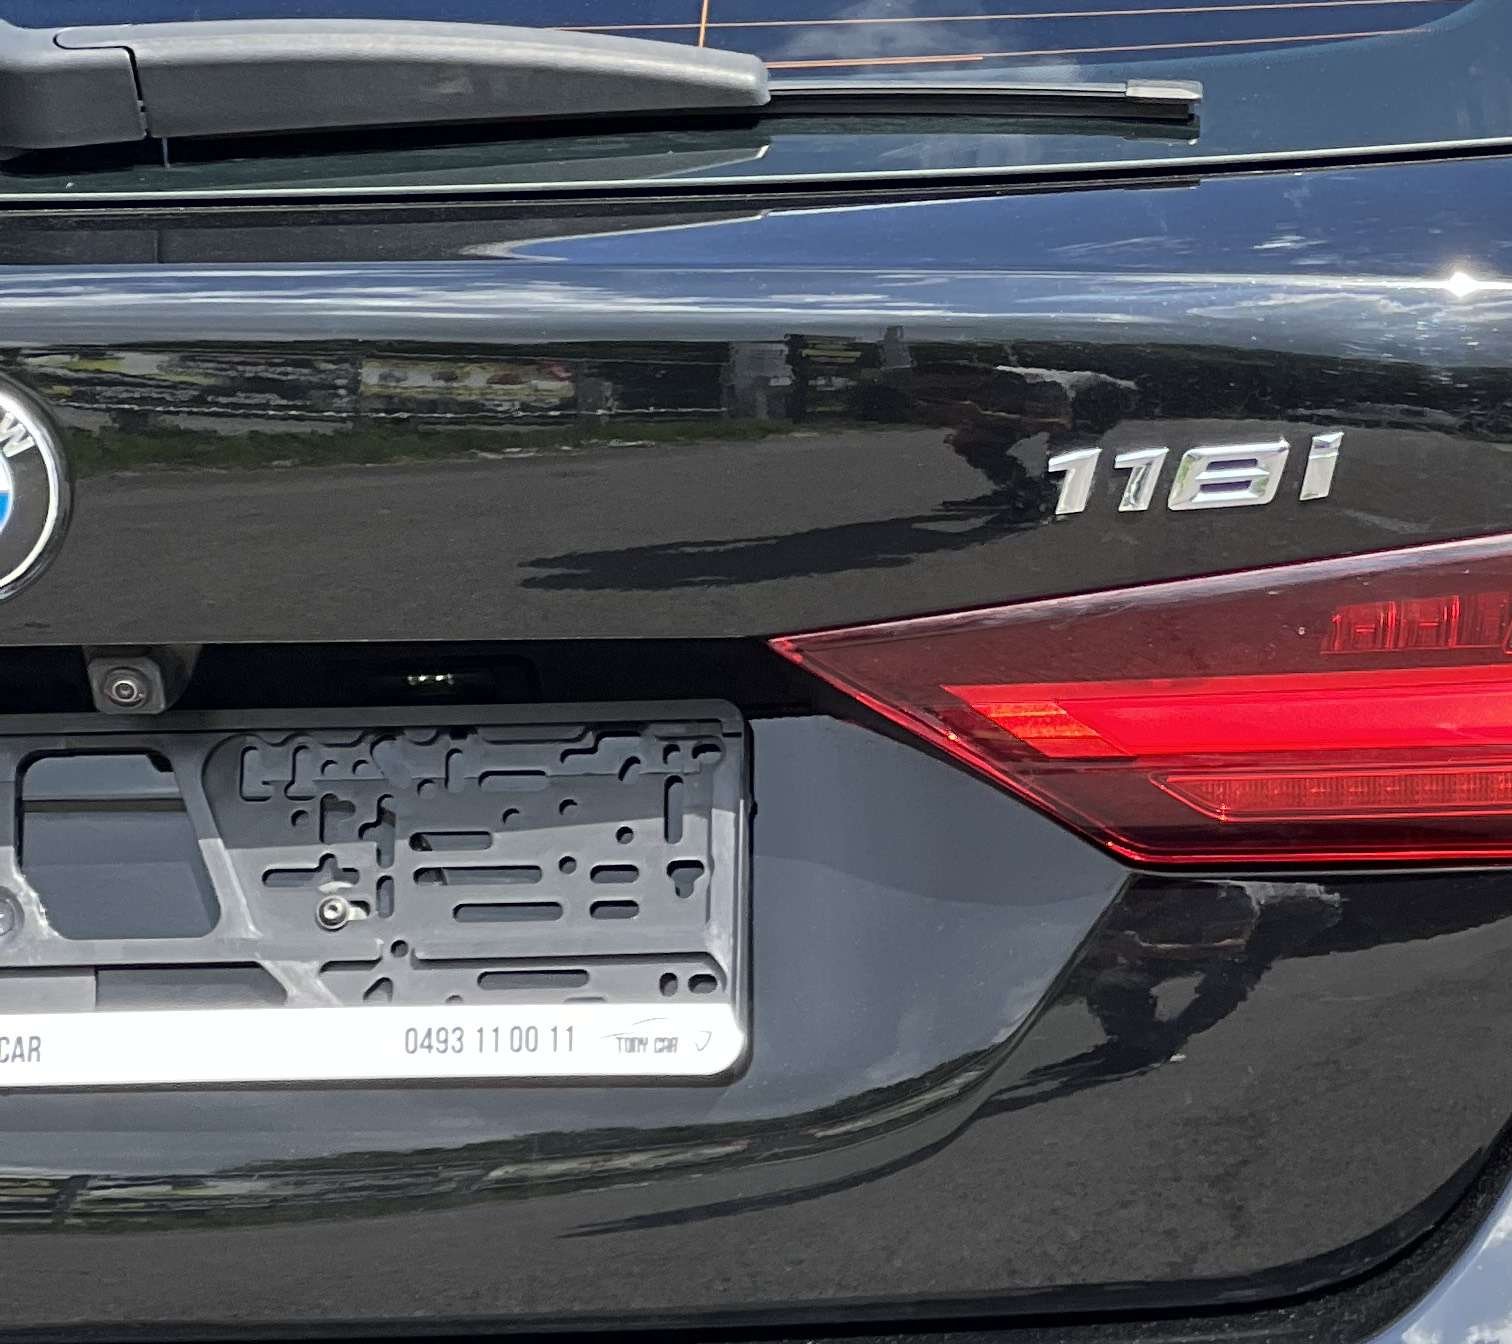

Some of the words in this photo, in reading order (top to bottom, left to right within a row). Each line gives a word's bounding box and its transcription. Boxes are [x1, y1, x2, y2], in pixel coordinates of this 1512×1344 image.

[1048, 432, 1344, 515] 118i
[0, 1035, 42, 1063] CAR
[404, 1026, 464, 1054] 0493
[476, 1026, 499, 1053] 11
[510, 1025, 538, 1053] 00
[550, 1025, 573, 1052] 11
